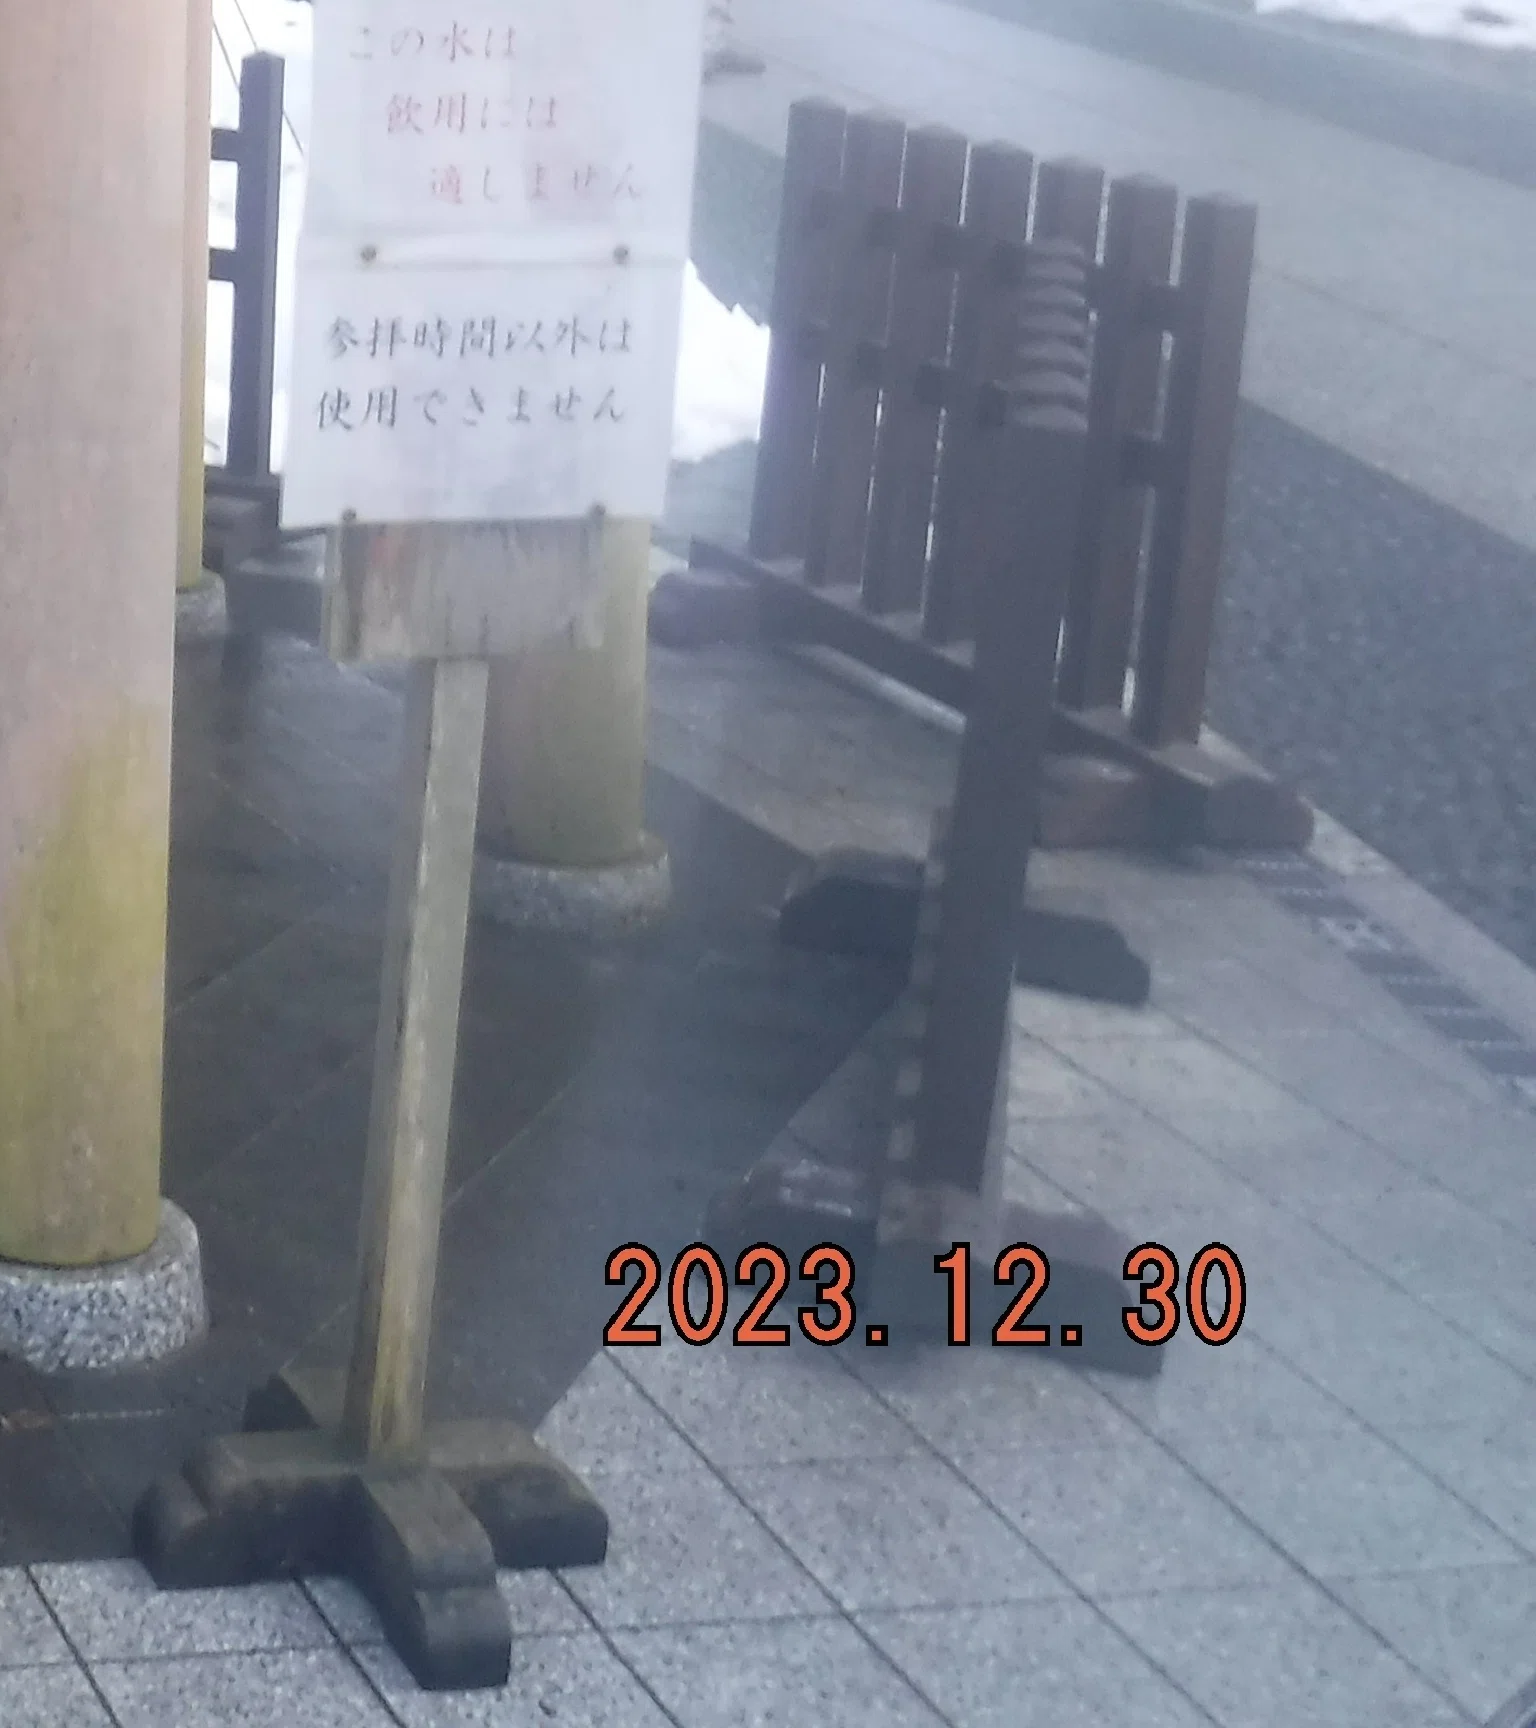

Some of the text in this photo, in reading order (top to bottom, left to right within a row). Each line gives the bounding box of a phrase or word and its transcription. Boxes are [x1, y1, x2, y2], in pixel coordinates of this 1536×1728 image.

[349, 19, 519, 62] この水は
[385, 92, 559, 136] 飲用には
[430, 165, 646, 205] 適しません
[327, 314, 634, 360] 参拝時間以外は
[316, 386, 625, 431] 使用できません
